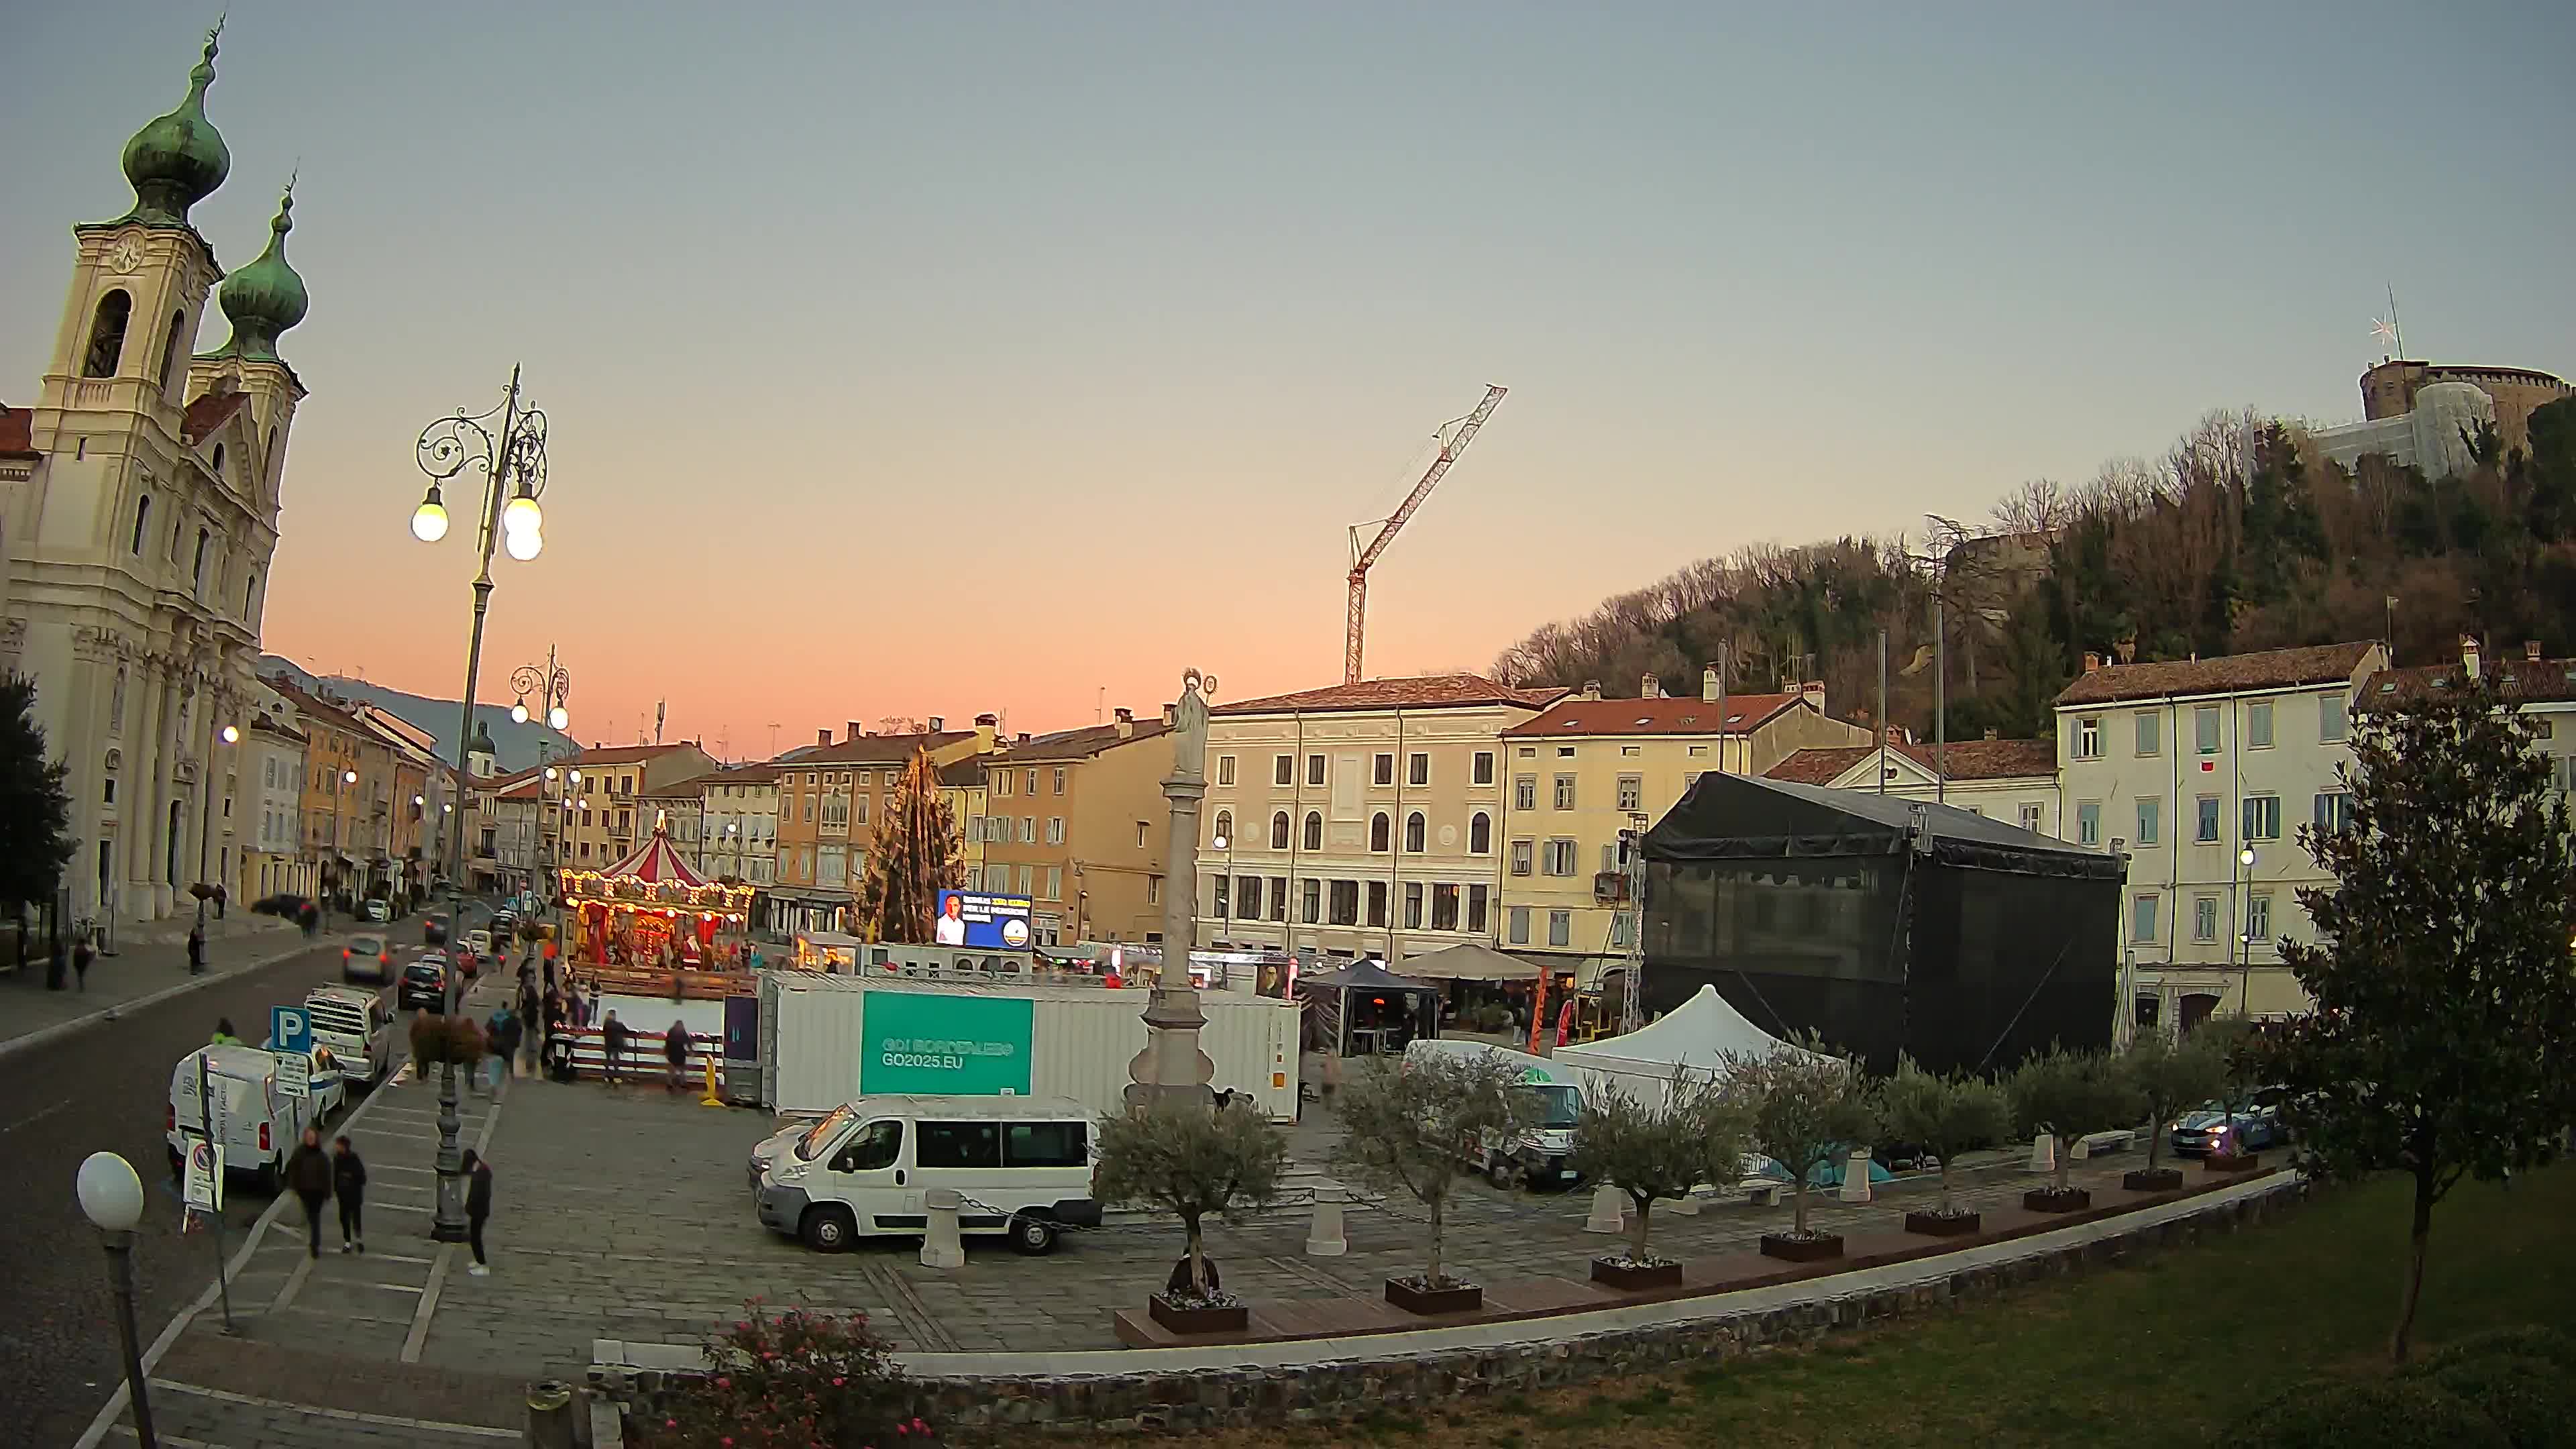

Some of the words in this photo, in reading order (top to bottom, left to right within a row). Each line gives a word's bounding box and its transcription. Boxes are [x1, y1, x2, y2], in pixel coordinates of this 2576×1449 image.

[279, 1011, 303, 1046] P
[883, 1038, 910, 1052] GO!
[882, 1053, 963, 1069] GO2025.EU
